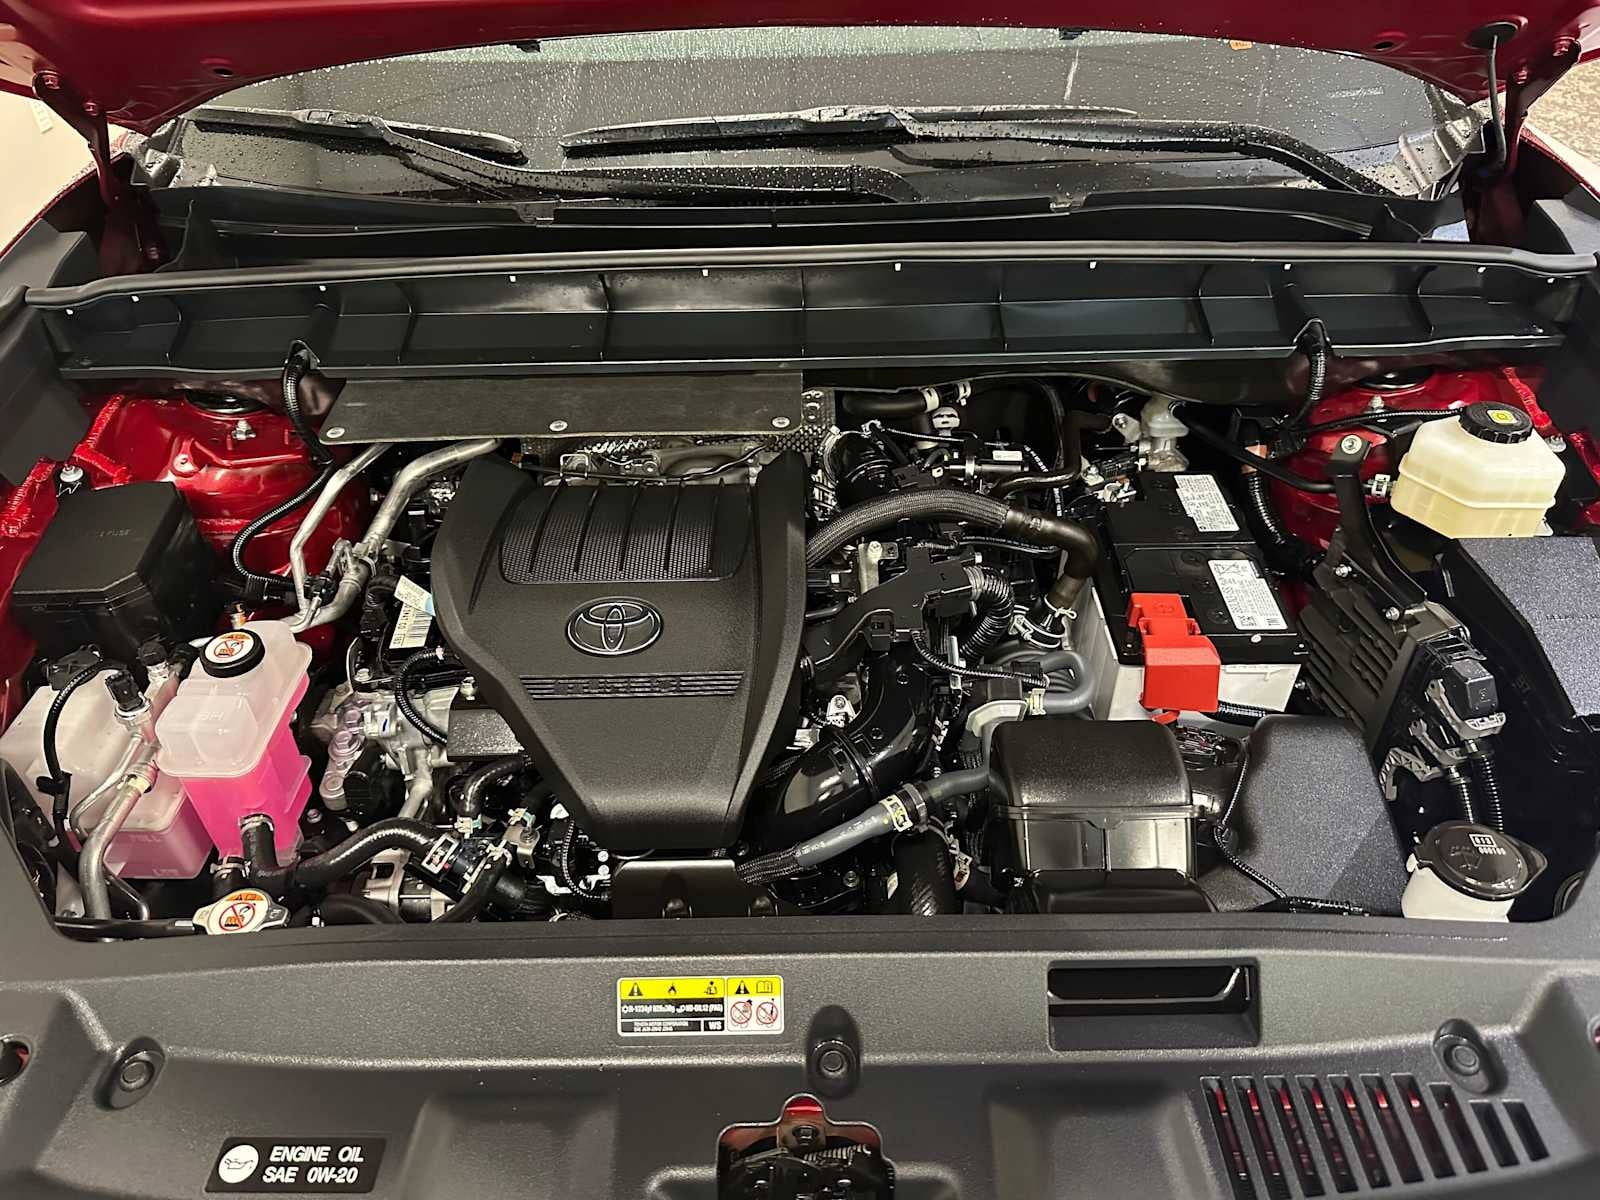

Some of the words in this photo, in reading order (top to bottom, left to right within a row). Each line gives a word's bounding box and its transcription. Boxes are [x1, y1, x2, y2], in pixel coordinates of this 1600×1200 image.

[708, 1021, 723, 1030] WS
[269, 1146, 331, 1162] ENGINE
[337, 1146, 364, 1162] OIL
[262, 1166, 299, 1183] SAE
[306, 1166, 359, 1183] 0W-20
